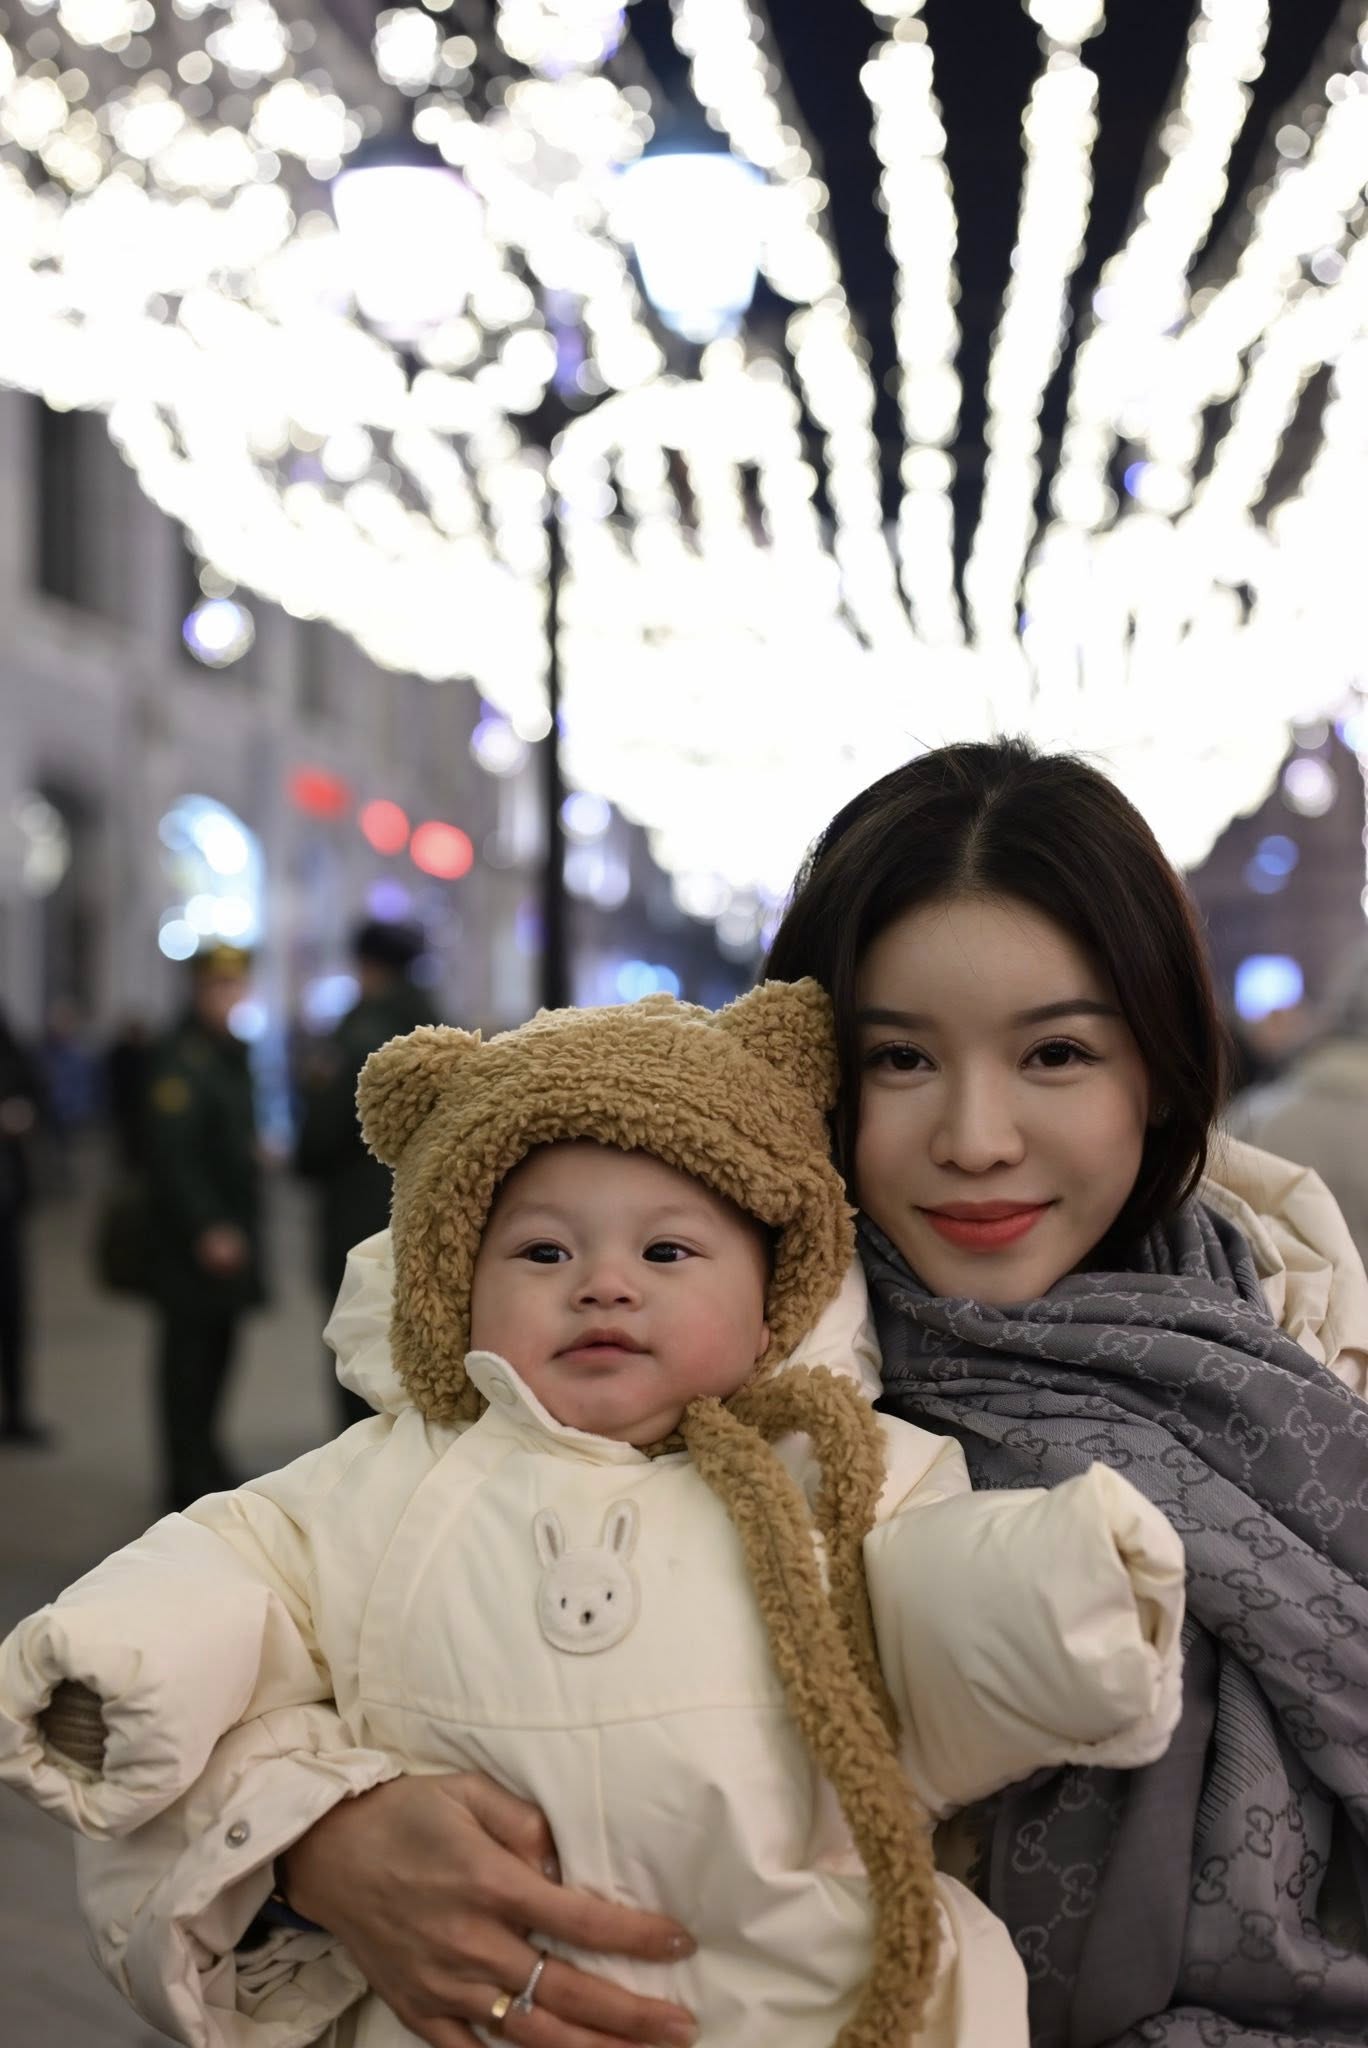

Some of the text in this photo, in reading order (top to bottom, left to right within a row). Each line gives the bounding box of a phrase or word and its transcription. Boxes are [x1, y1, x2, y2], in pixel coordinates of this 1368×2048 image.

[1098, 1329, 1153, 1360] GG
[1199, 1353, 1249, 1391] GG
[1075, 1434, 1133, 1468] GG
[1225, 1413, 1269, 1461] GG
[1285, 1404, 1330, 1457] GG
[1160, 1445, 1215, 1486] GG
[1296, 1479, 1344, 1532] GG
[1232, 1517, 1288, 1560] GG
[1222, 1568, 1281, 1610] GG
[1305, 1594, 1360, 1639] GG
[1291, 1650, 1347, 1694] GG
